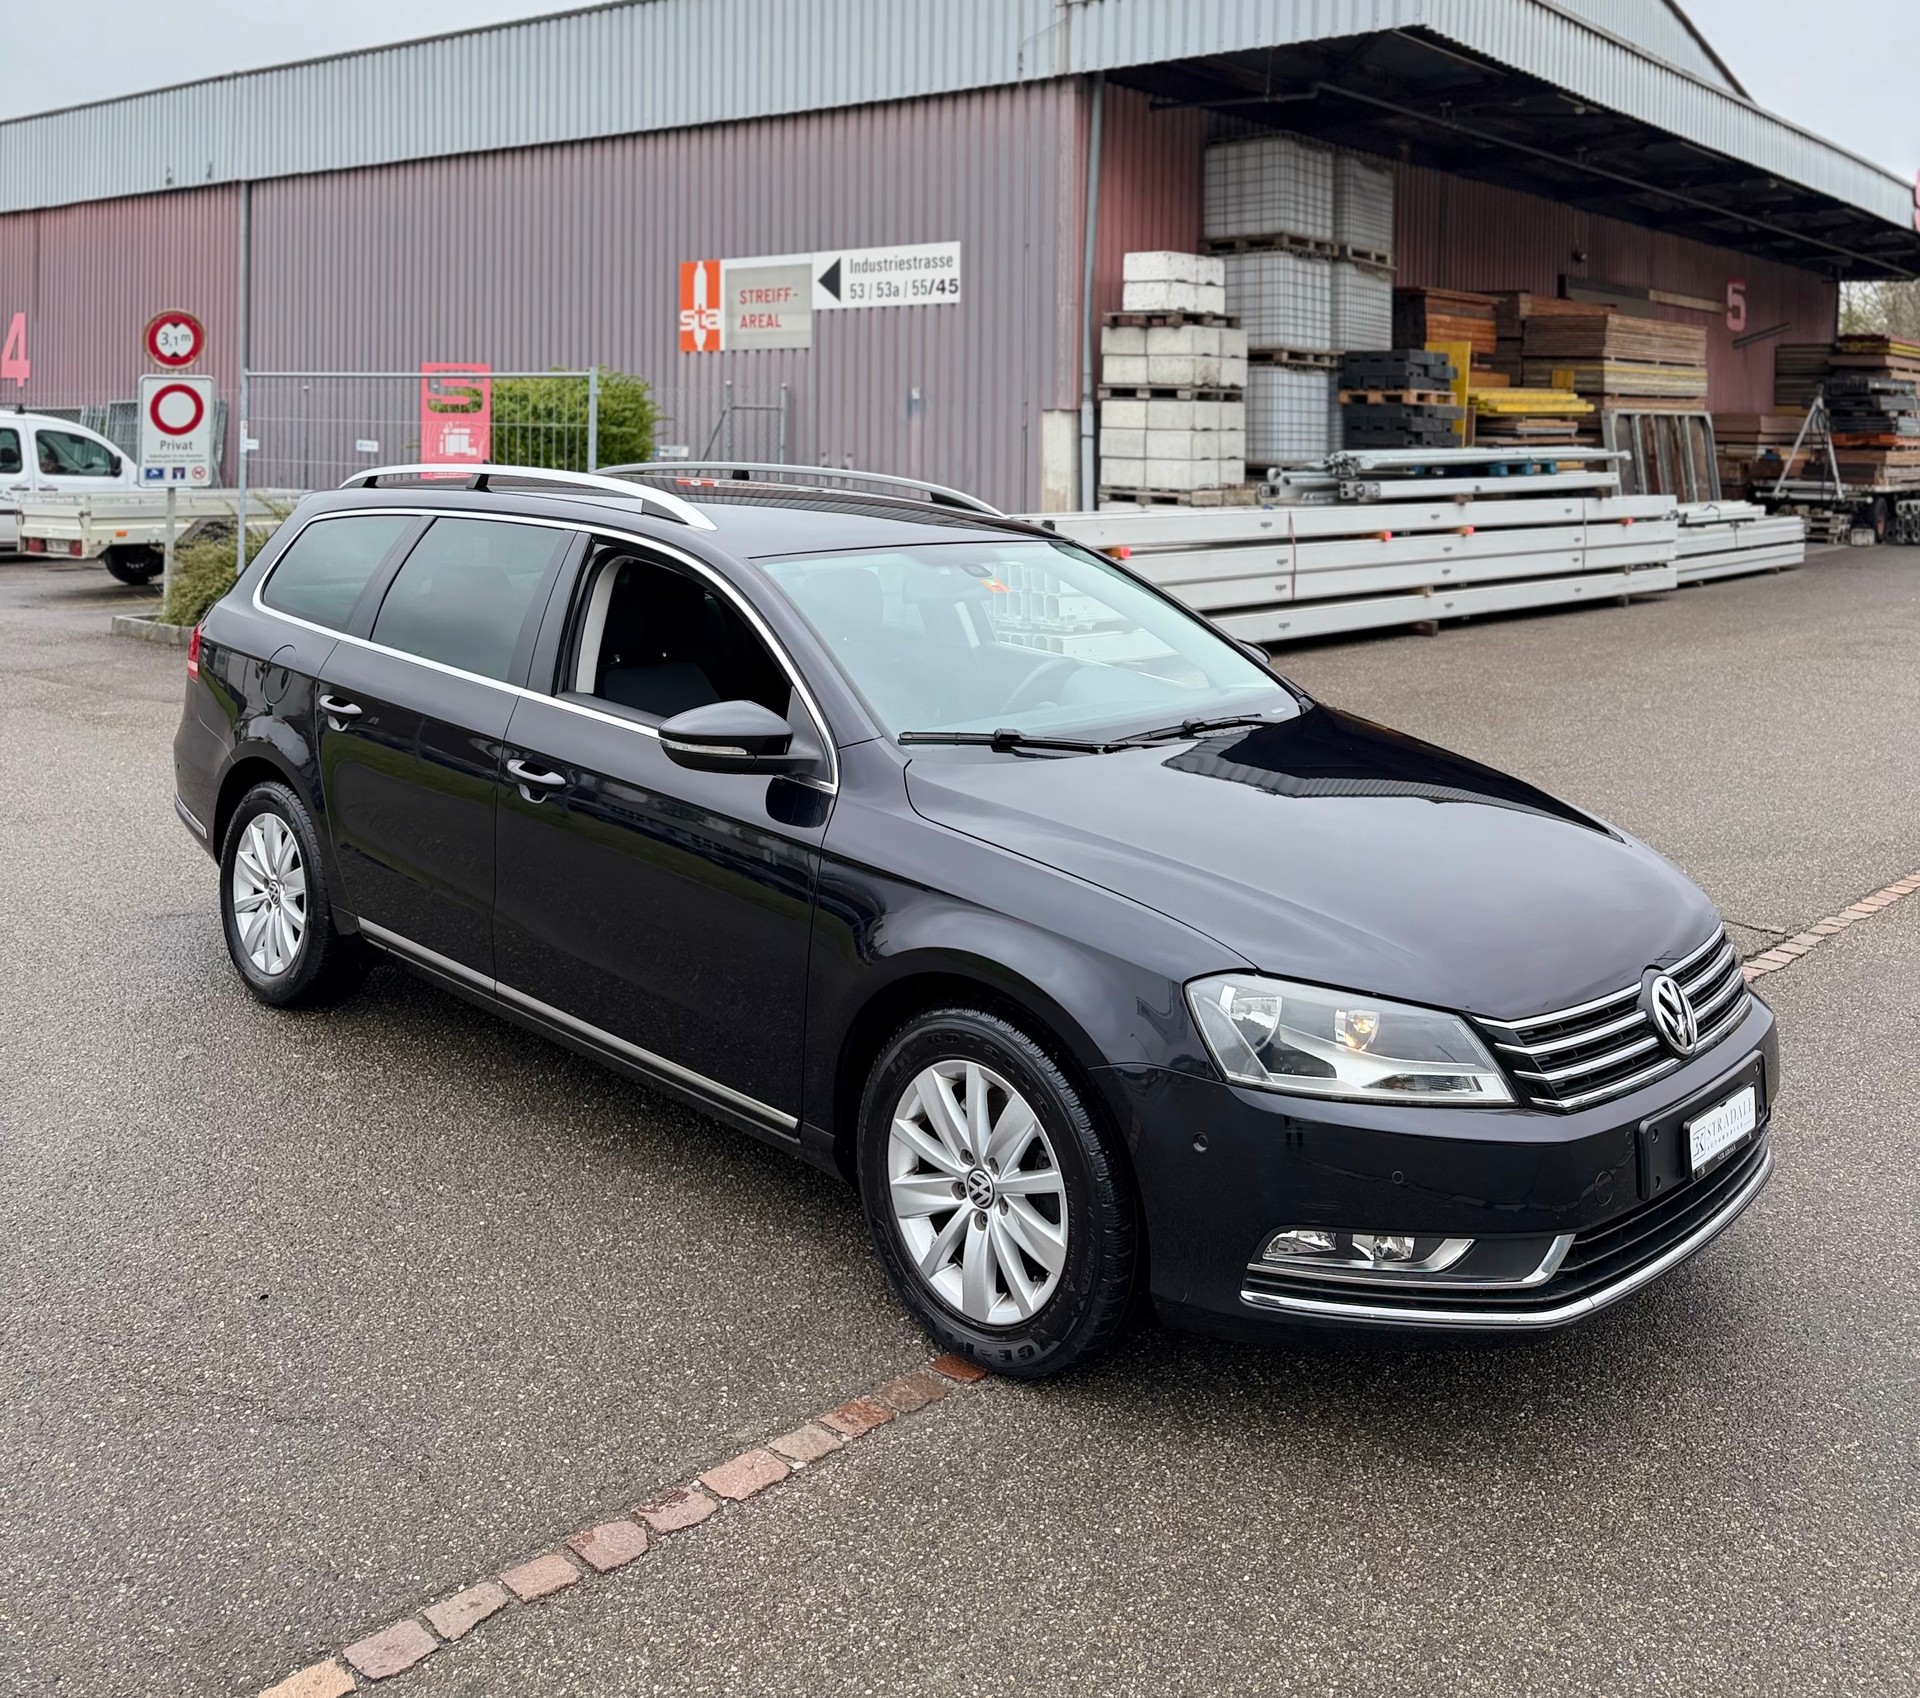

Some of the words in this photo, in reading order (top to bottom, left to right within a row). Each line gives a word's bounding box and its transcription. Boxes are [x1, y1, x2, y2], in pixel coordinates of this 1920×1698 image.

[850, 255, 953, 273] Industriestrasse
[739, 287, 799, 304] STREIFF-
[850, 283, 865, 299] 53
[876, 281, 900, 298] 53a
[1727, 276, 1746, 332] 5
[740, 314, 782, 329] AREAL
[1, 311, 31, 388] 4
[160, 439, 193, 450] Privat
[1706, 1097, 1753, 1140] STRADALE
